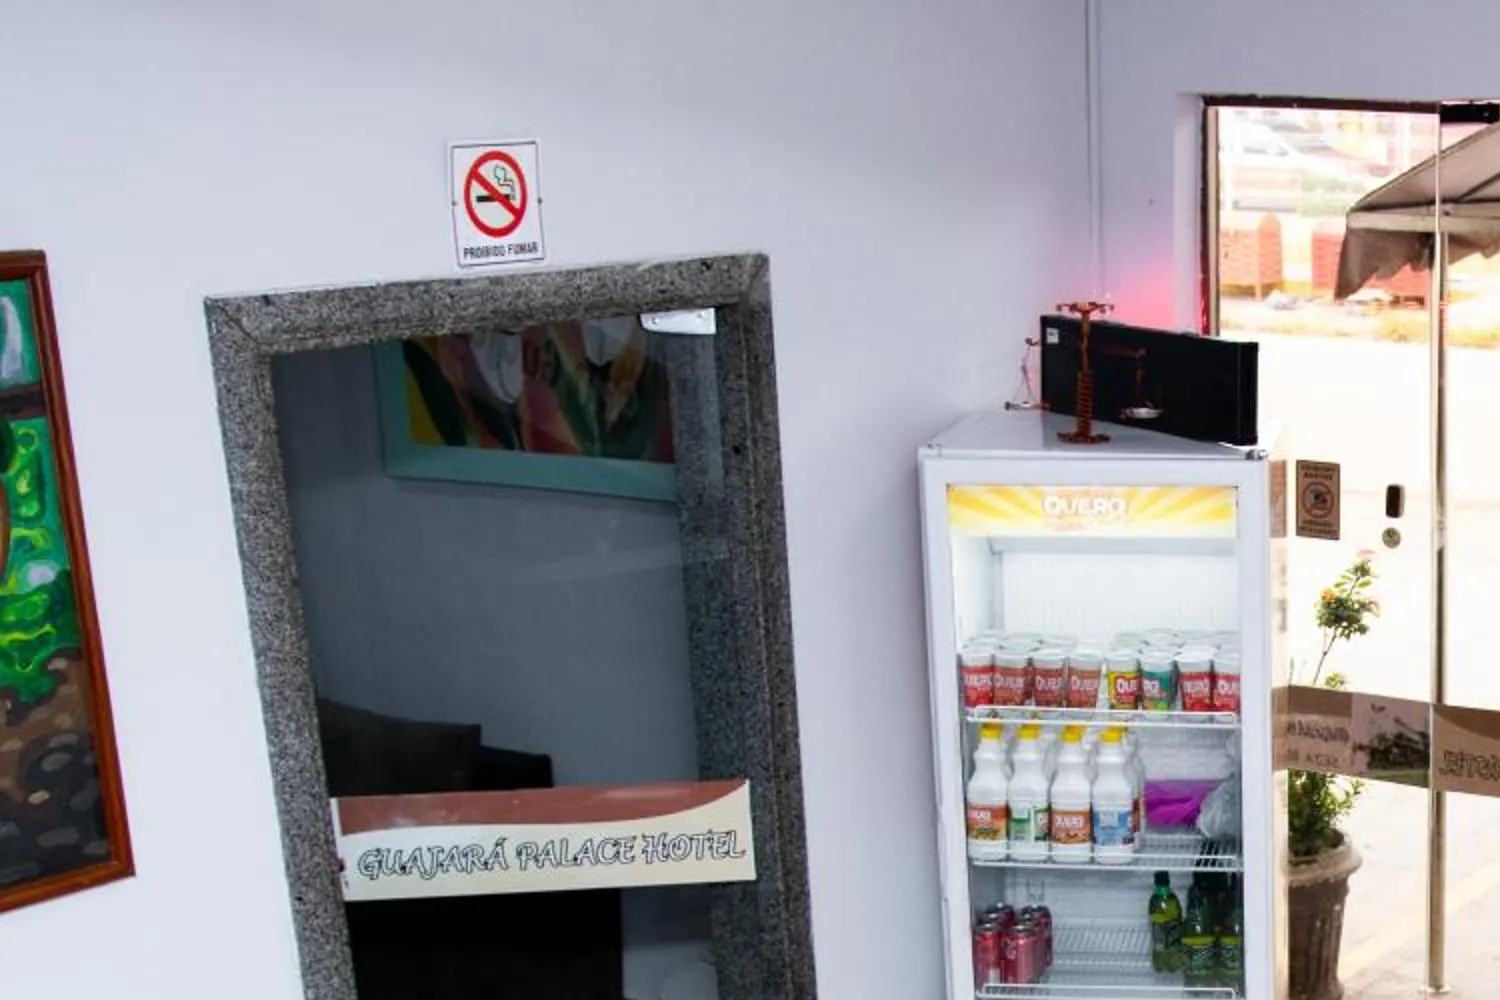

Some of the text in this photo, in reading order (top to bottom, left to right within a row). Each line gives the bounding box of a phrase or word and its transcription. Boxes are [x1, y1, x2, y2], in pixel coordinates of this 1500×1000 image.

[463, 241, 539, 259] PROIBIDO FUMAR
[357, 829, 746, 880] GUAJARÁ PALACE HOTEL
